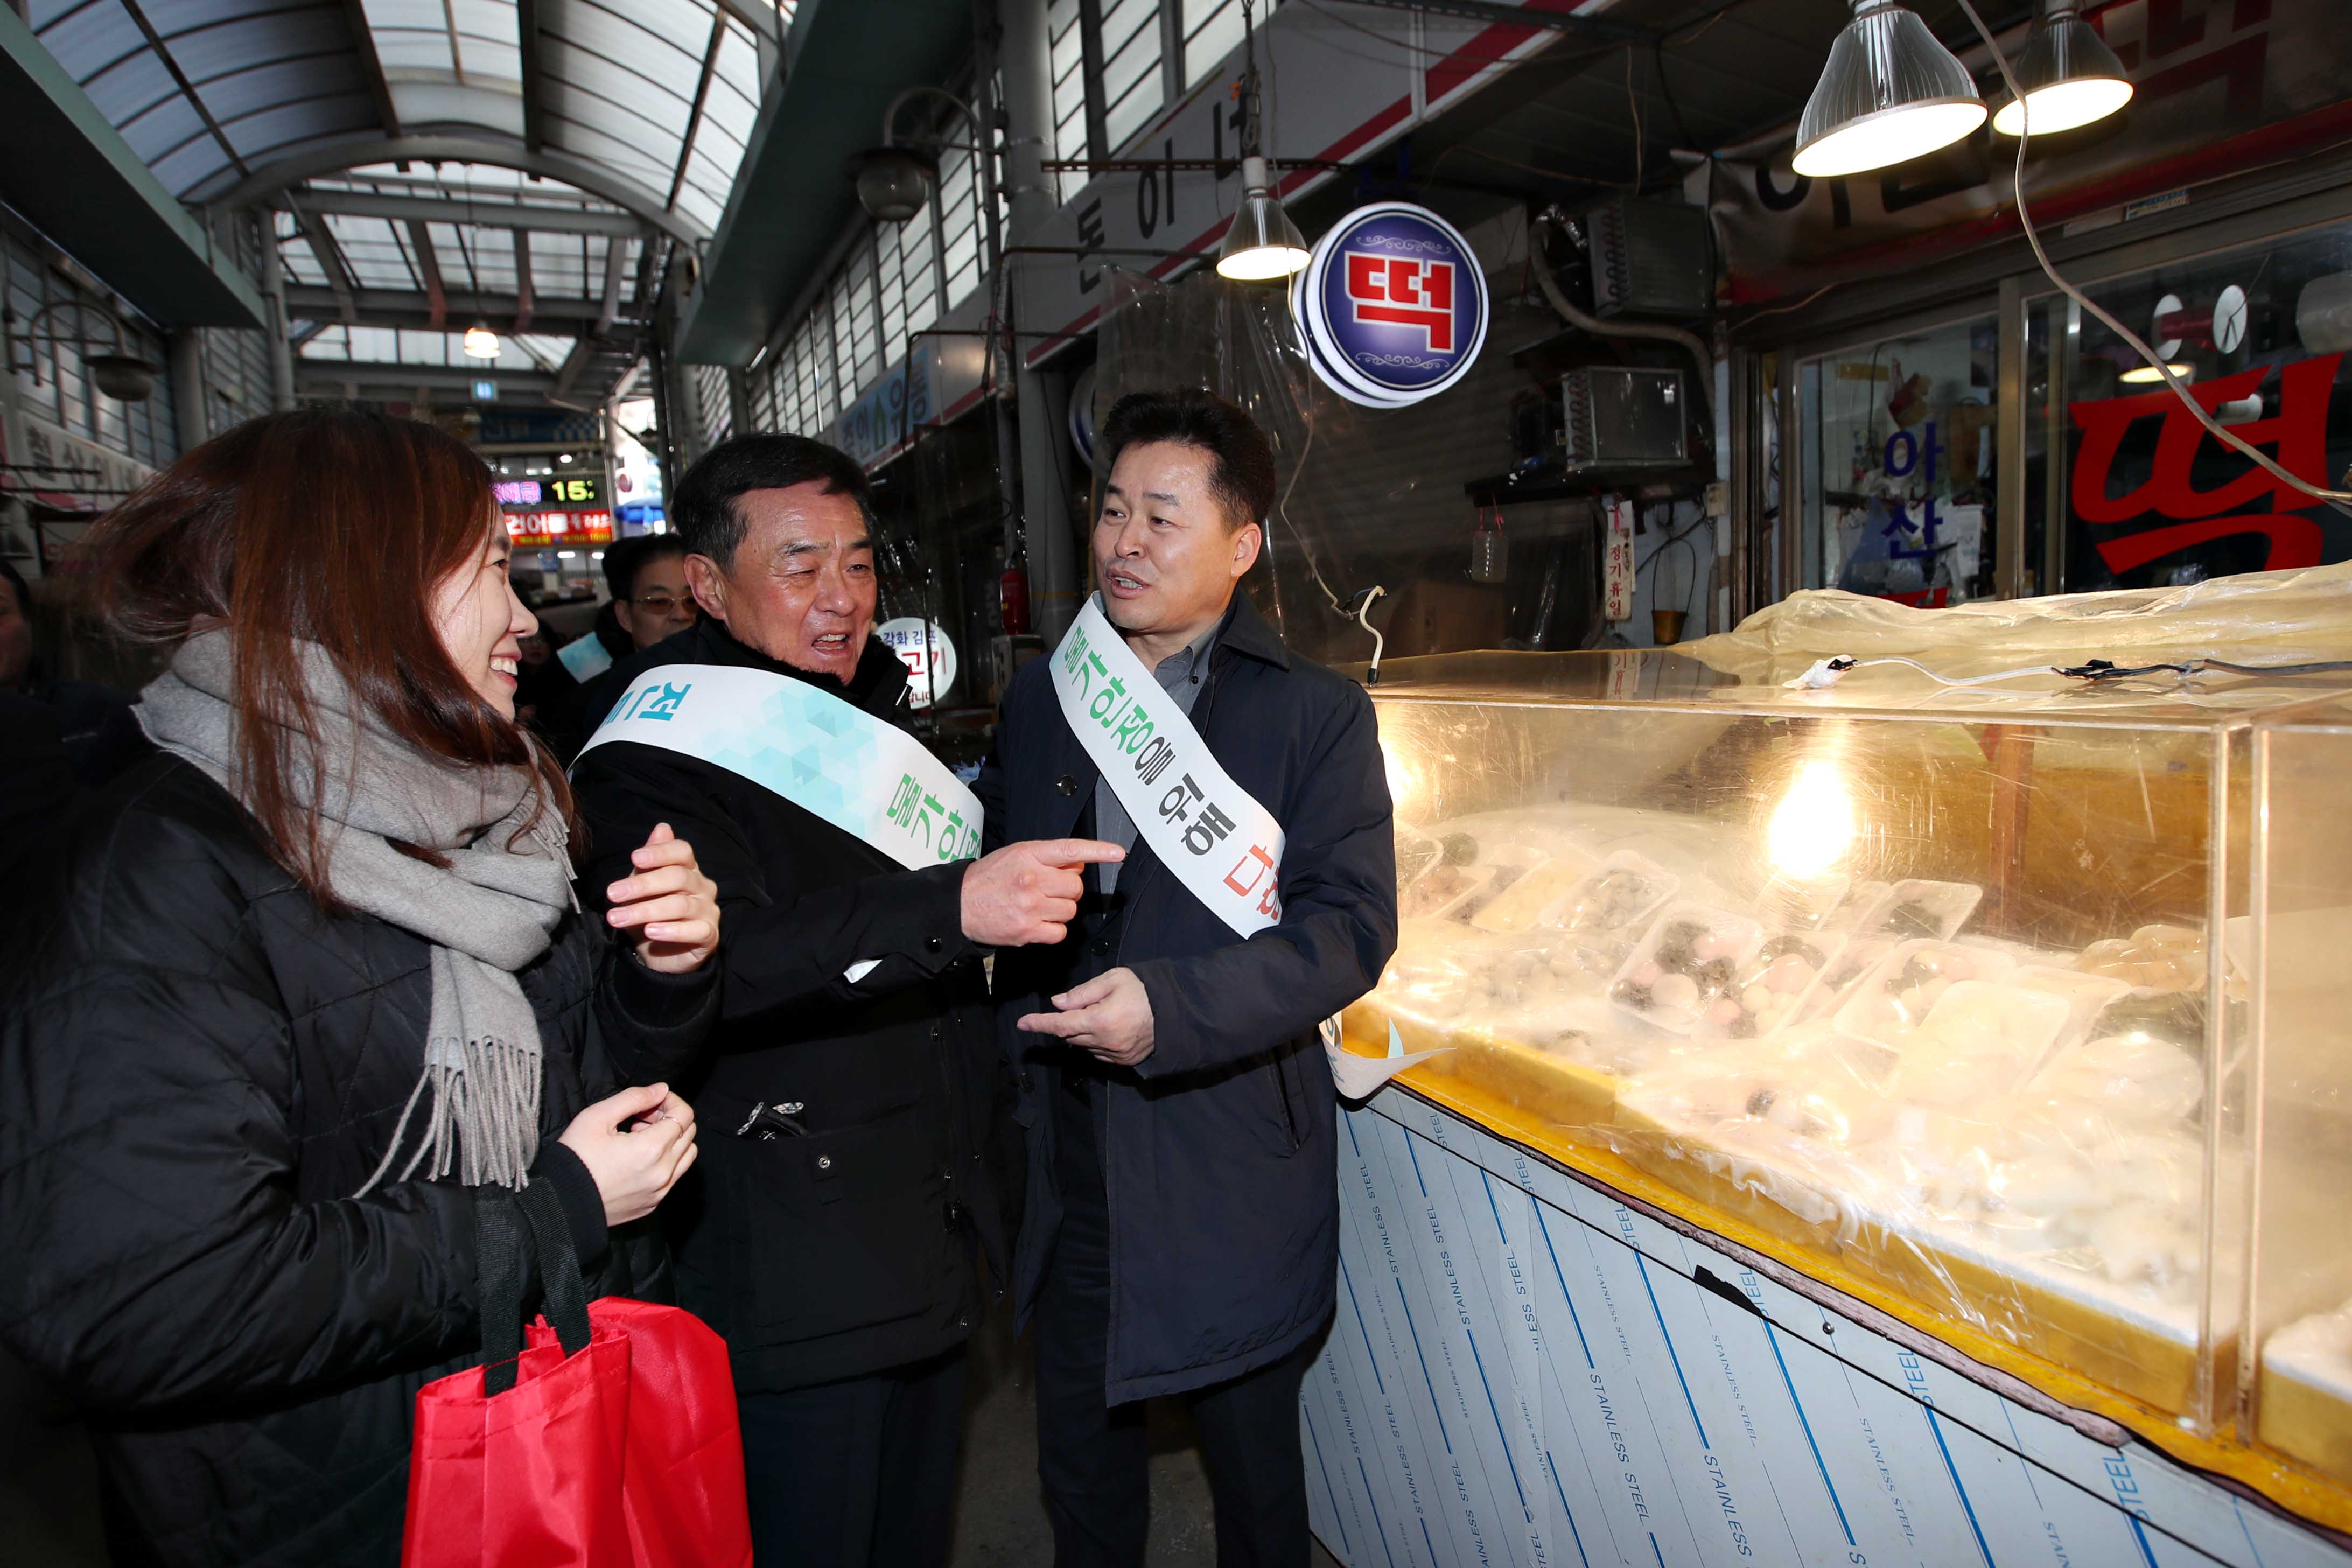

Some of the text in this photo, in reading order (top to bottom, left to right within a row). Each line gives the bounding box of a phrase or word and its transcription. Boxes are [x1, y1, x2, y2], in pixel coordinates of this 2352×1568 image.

[1345, 251, 1455, 354] 떡
[1881, 422, 1944, 559] 아산
[2068, 351, 2343, 575] 떡
[505, 513, 569, 535] 건어
[883, 631, 908, 647] 강화
[895, 647, 947, 676] 고기
[1065, 625, 1176, 786] 물가안정을
[1159, 773, 1236, 856] 위해
[1360, 1160, 1399, 1273] STAINLESS STEEL
[1427, 1200, 1470, 1325] STAINLESS STEEL
[1507, 1248, 1526, 1295] STEEL
[1594, 1265, 1619, 1322] STAINLESS
[1325, 1348, 1339, 1384] STEEL
[1712, 1334, 1757, 1448] STAINLESS STEEL
[1336, 1391, 1361, 1454] STAINLESS
[1384, 1398, 1401, 1438] STEEL
[1590, 1374, 1649, 1525] STAINLESS STEEL
[1397, 1445, 1423, 1514] STAINLESS
[1451, 1459, 1490, 1568] AINLESS STEEL
[1704, 1455, 1752, 1557] STAINLESS
[1860, 1417, 1915, 1546] STAINLESS STEEL
[1531, 1529, 1548, 1568] TEEL
